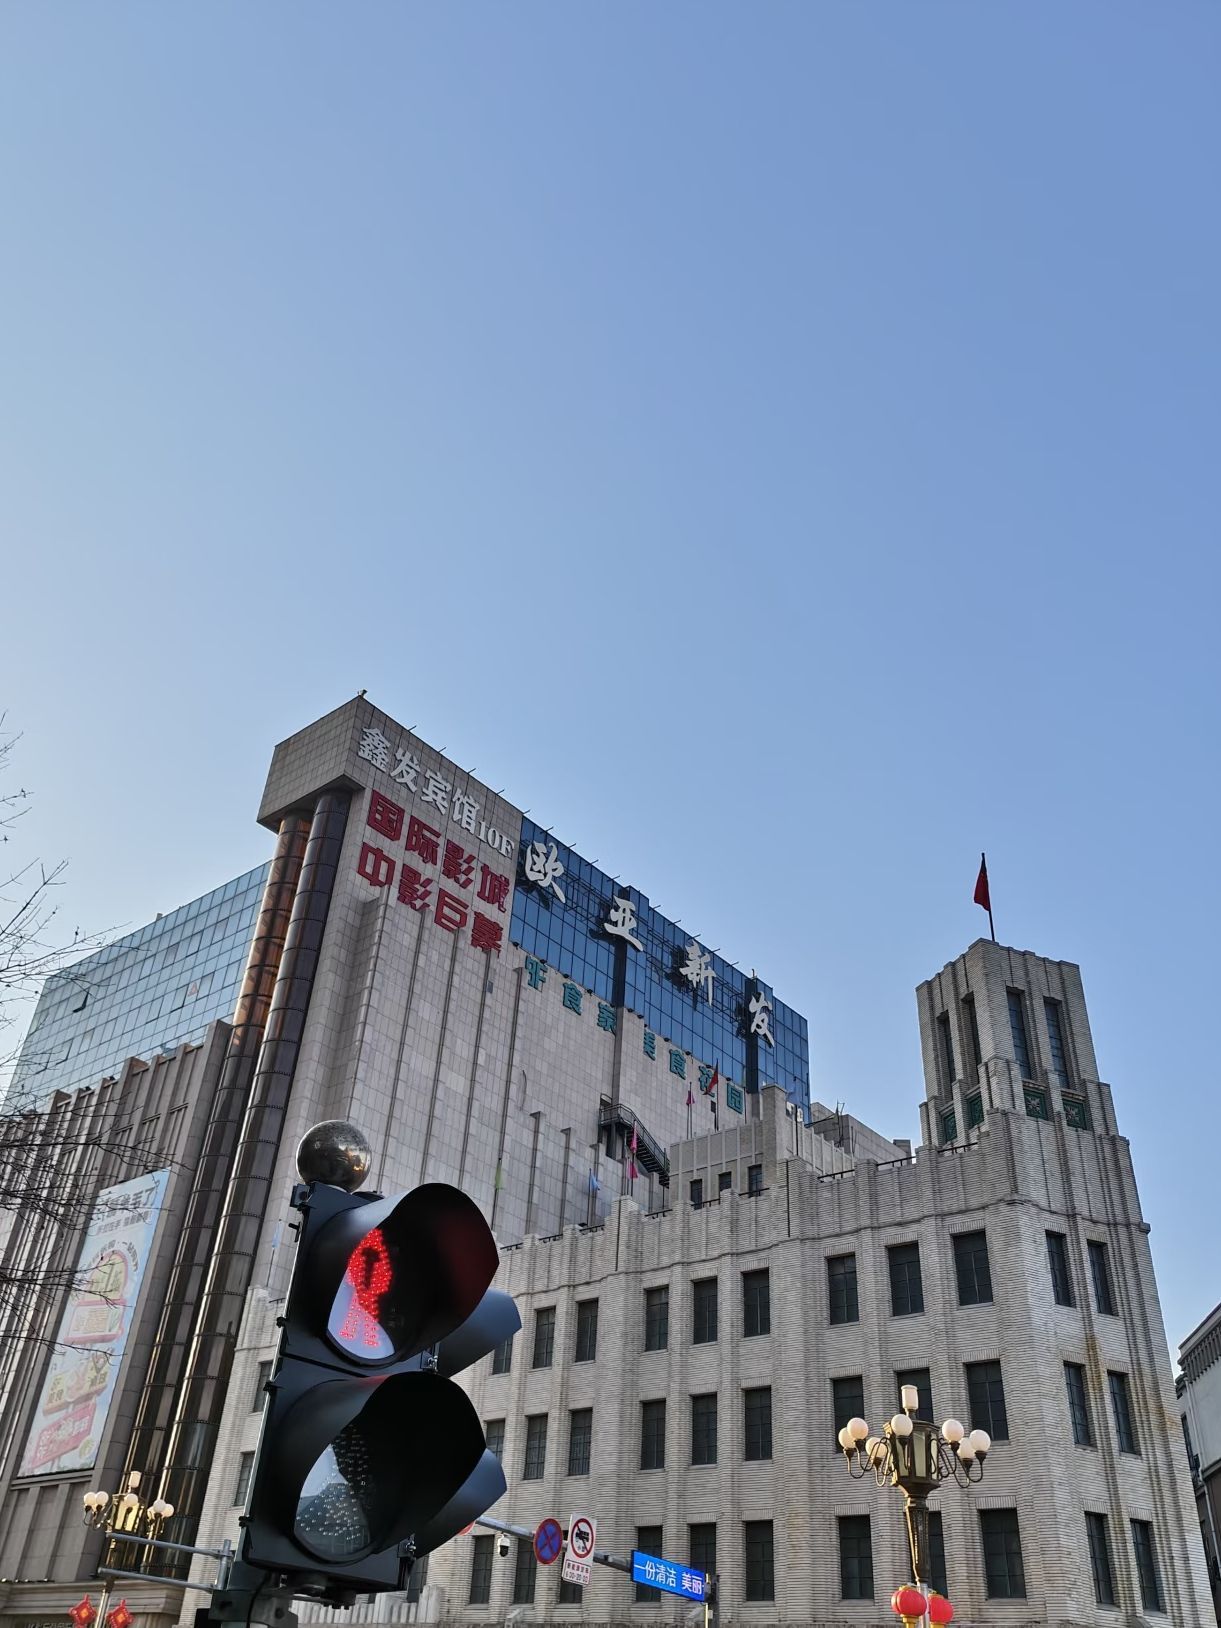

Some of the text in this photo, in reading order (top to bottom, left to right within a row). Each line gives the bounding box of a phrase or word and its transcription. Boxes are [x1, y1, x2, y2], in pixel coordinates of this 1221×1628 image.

[357, 841, 505, 958] 中影巨幕
[366, 788, 511, 913] 国际影城
[524, 842, 775, 1048] 欧亚新发
[634, 1560, 705, 1595] 一份清洁 美丽
